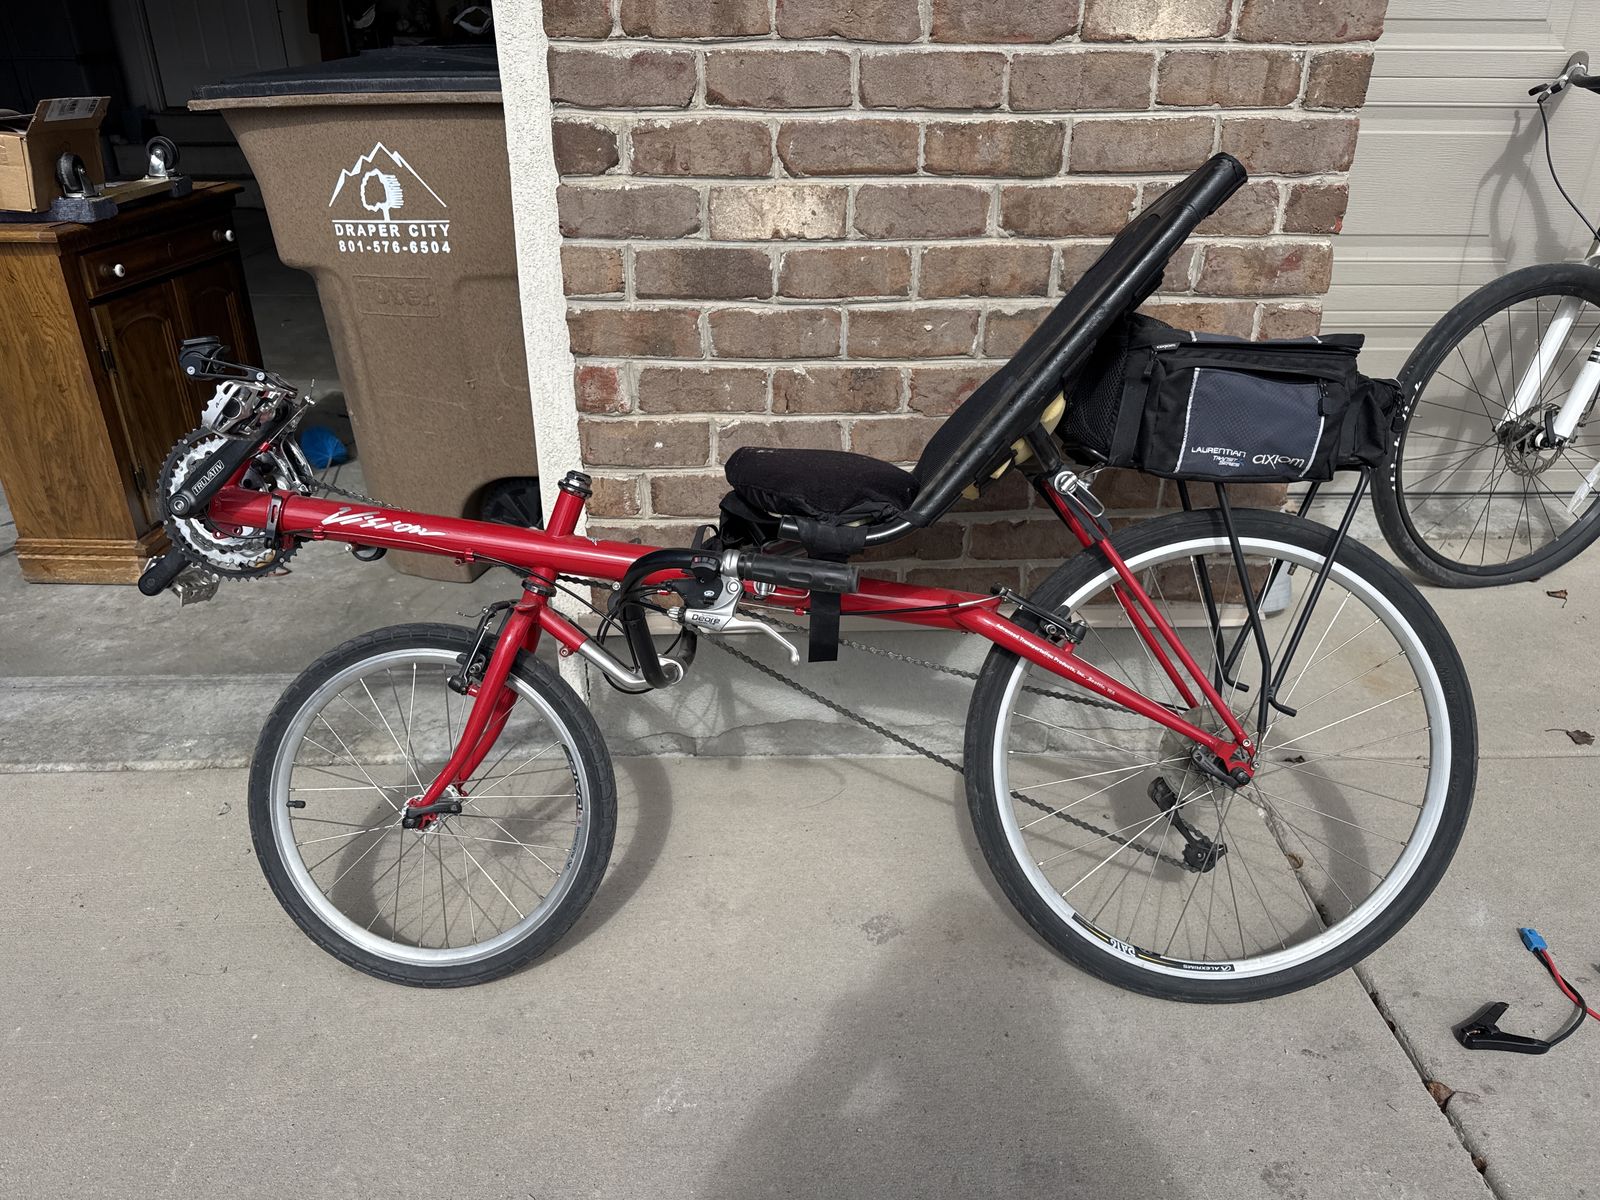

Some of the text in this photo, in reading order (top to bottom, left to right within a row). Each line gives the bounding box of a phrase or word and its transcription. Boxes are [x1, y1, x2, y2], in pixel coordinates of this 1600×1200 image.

[335, 224, 450, 237] DRAPER CITY
[339, 240, 451, 254] 801-576-6504
[1191, 446, 1246, 458] LAURENTIAN
[1252, 454, 1304, 470] axiom
[193, 461, 223, 494] TRUVATIV
[321, 506, 446, 535] Vision
[692, 613, 721, 625] Deore
[1183, 963, 1219, 971] ALEXRIMS
